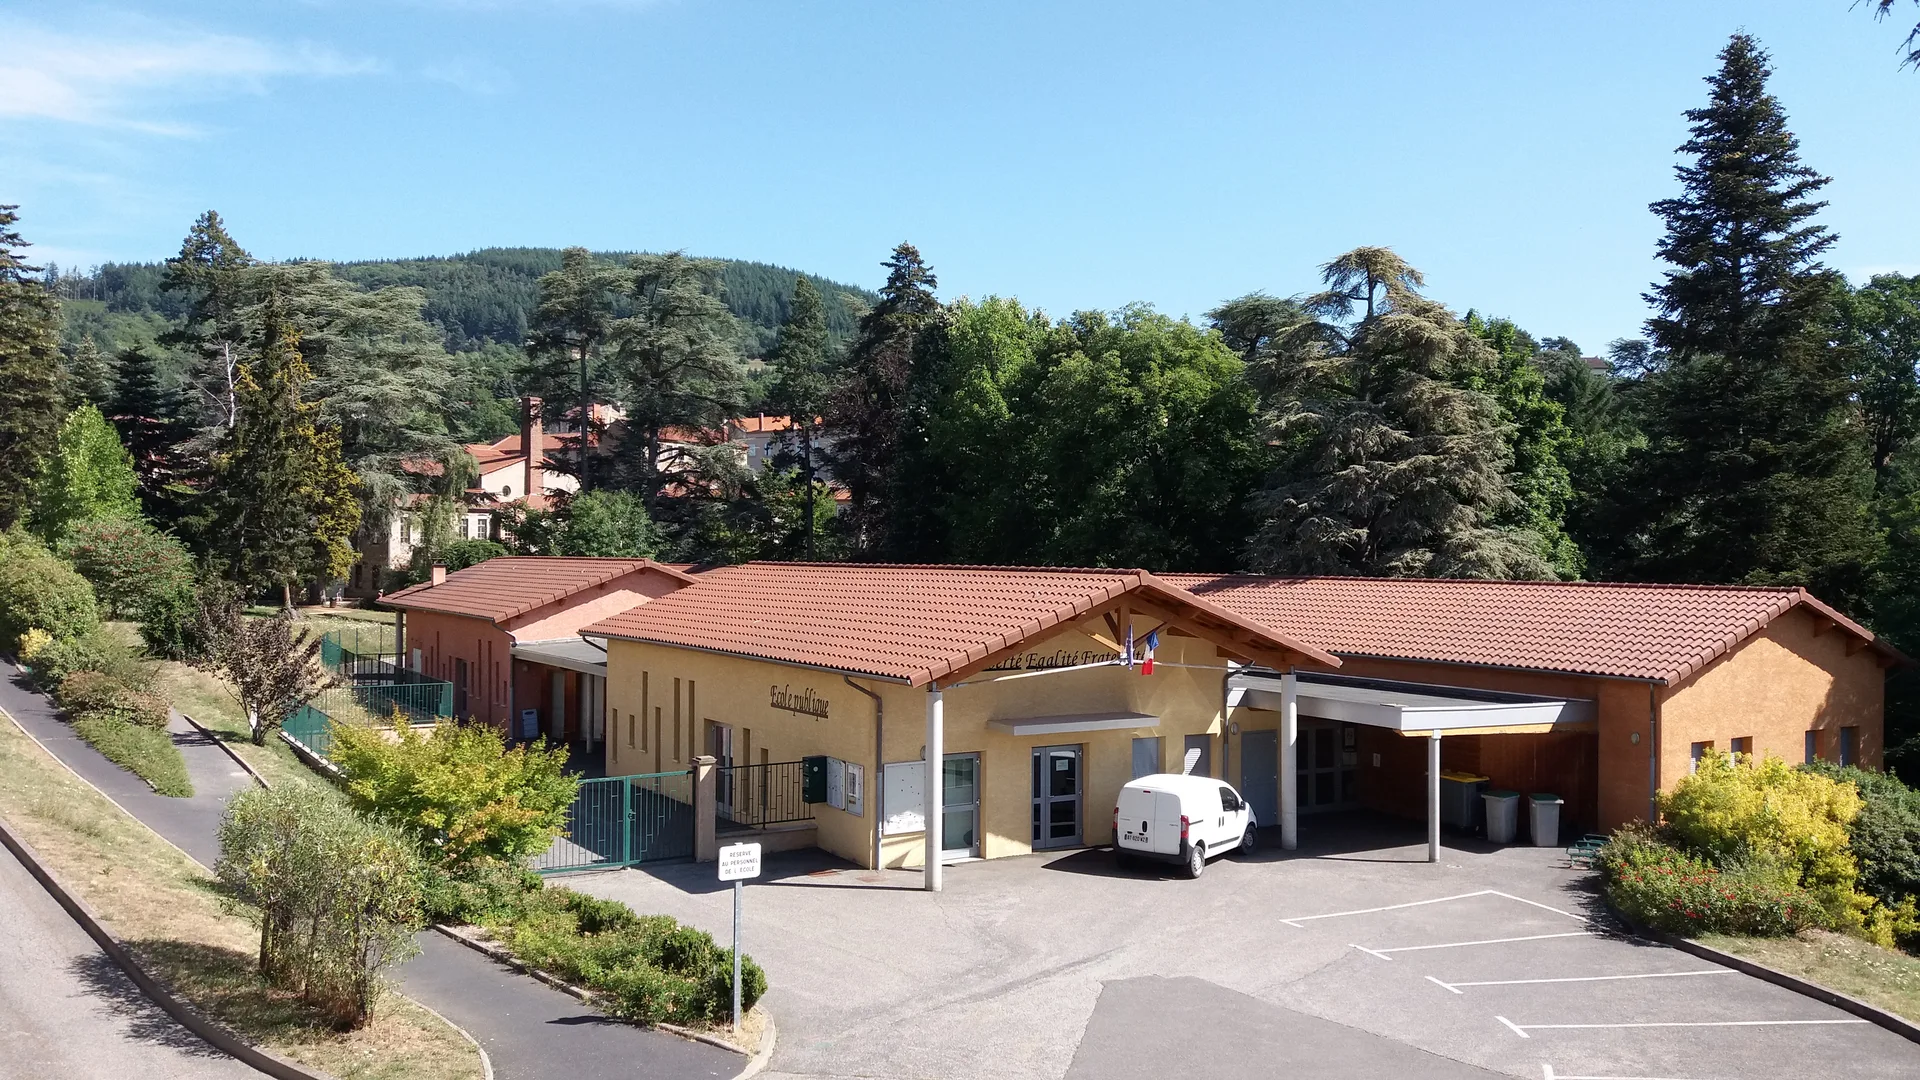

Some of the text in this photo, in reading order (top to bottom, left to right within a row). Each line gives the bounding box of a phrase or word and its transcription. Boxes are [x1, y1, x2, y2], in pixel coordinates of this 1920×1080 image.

[1026, 650, 1079, 671] Egalité
[770, 684, 829, 721] Ecole publique
[730, 857, 759, 866] PERSONNEL
